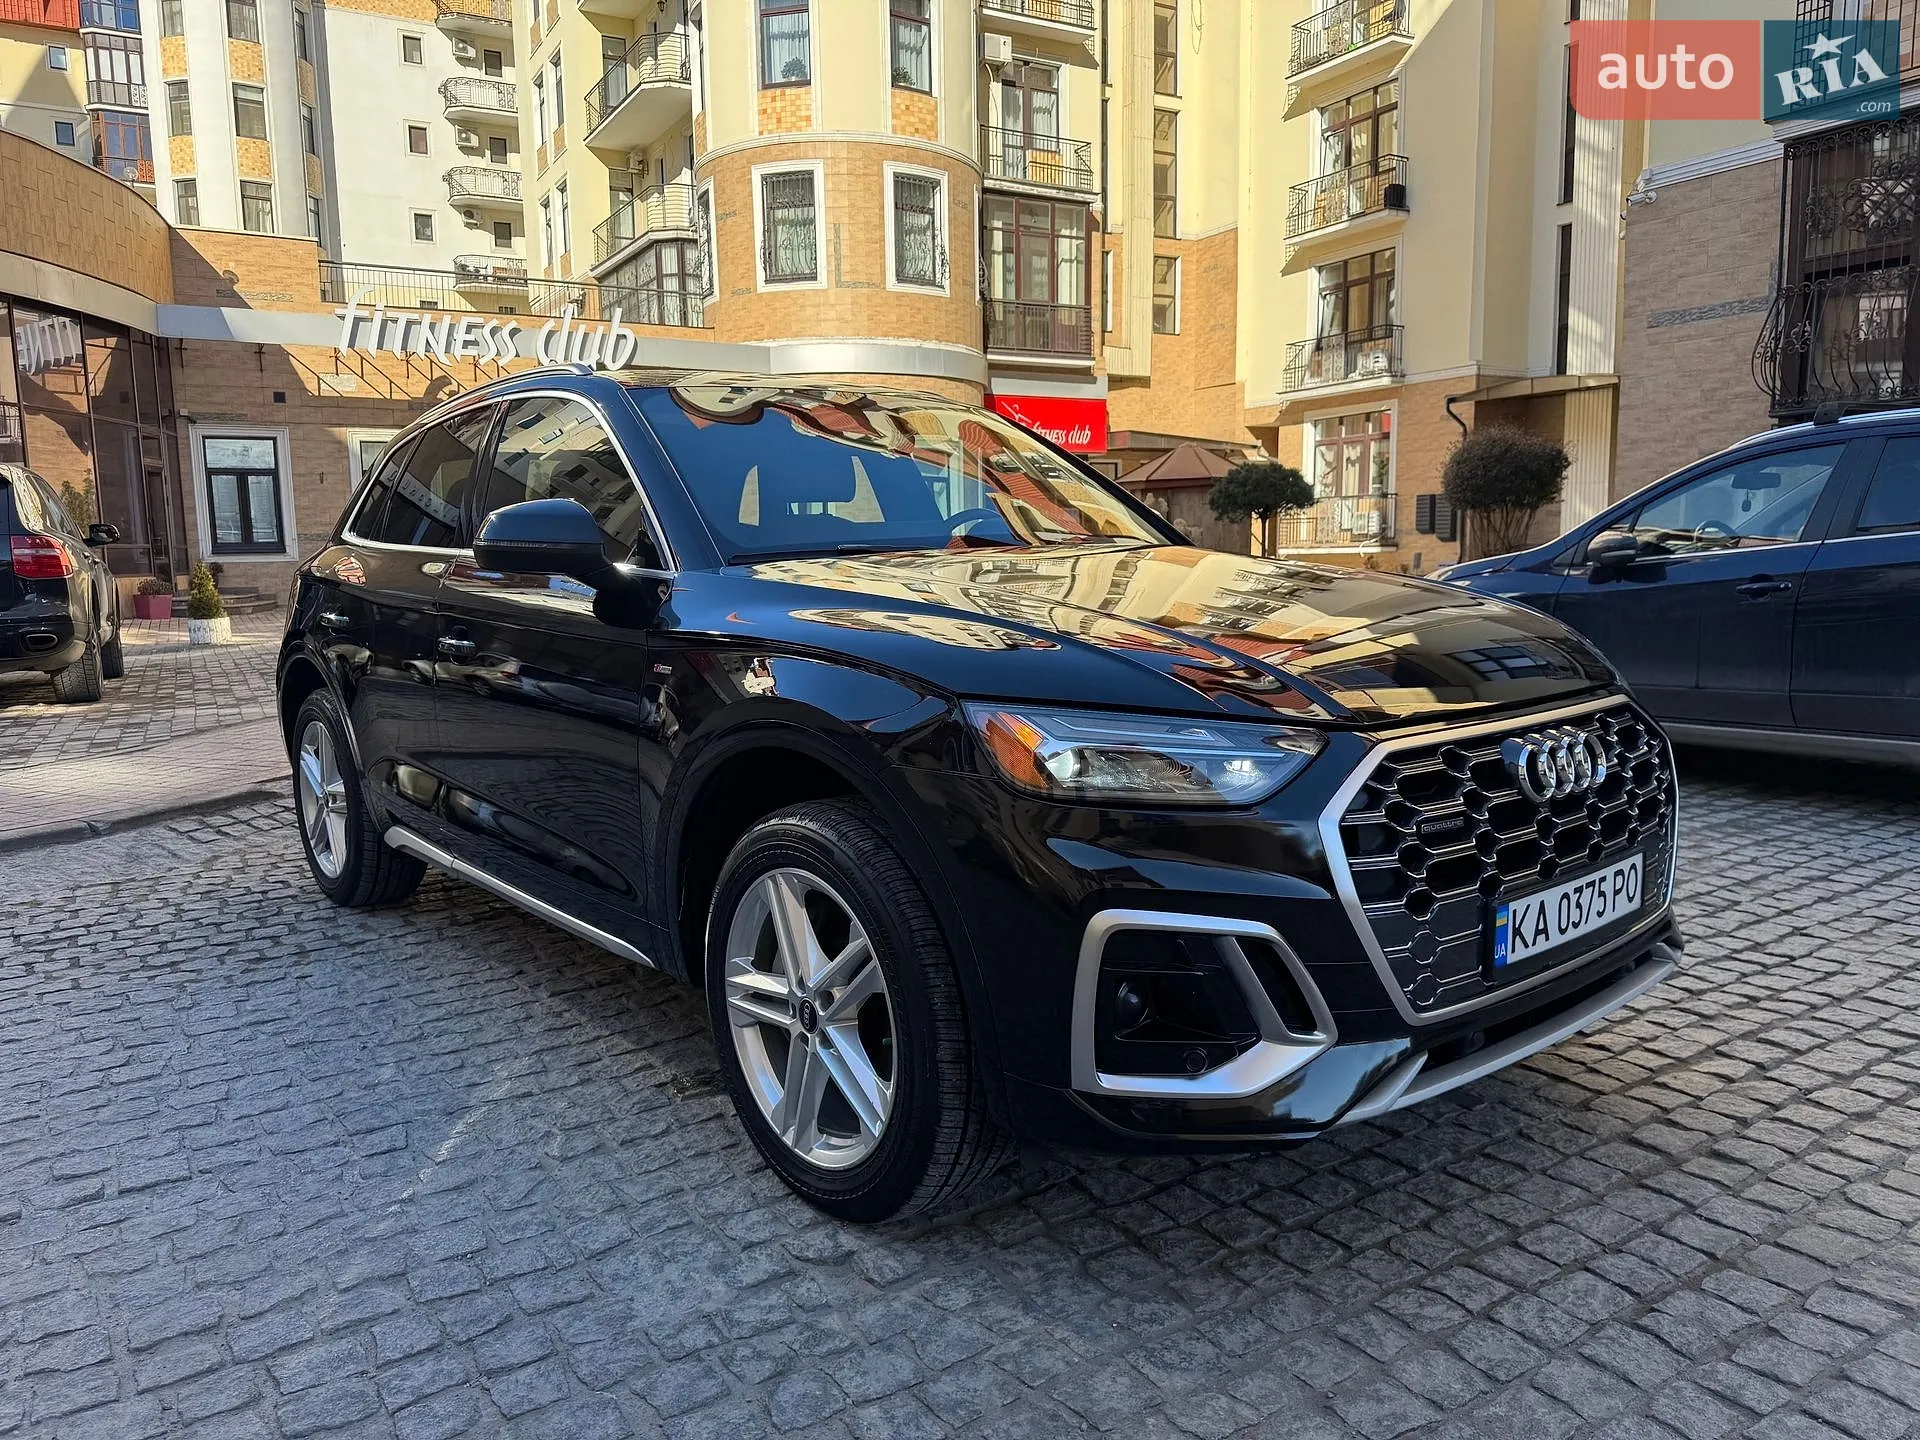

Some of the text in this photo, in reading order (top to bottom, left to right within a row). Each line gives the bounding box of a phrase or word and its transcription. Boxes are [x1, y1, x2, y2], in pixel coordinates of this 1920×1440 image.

[536, 302, 637, 371] club
[1423, 819, 1464, 832] quattro
[1511, 862, 1638, 954] KA 0375 PO
[1494, 945, 1506, 959] UA
